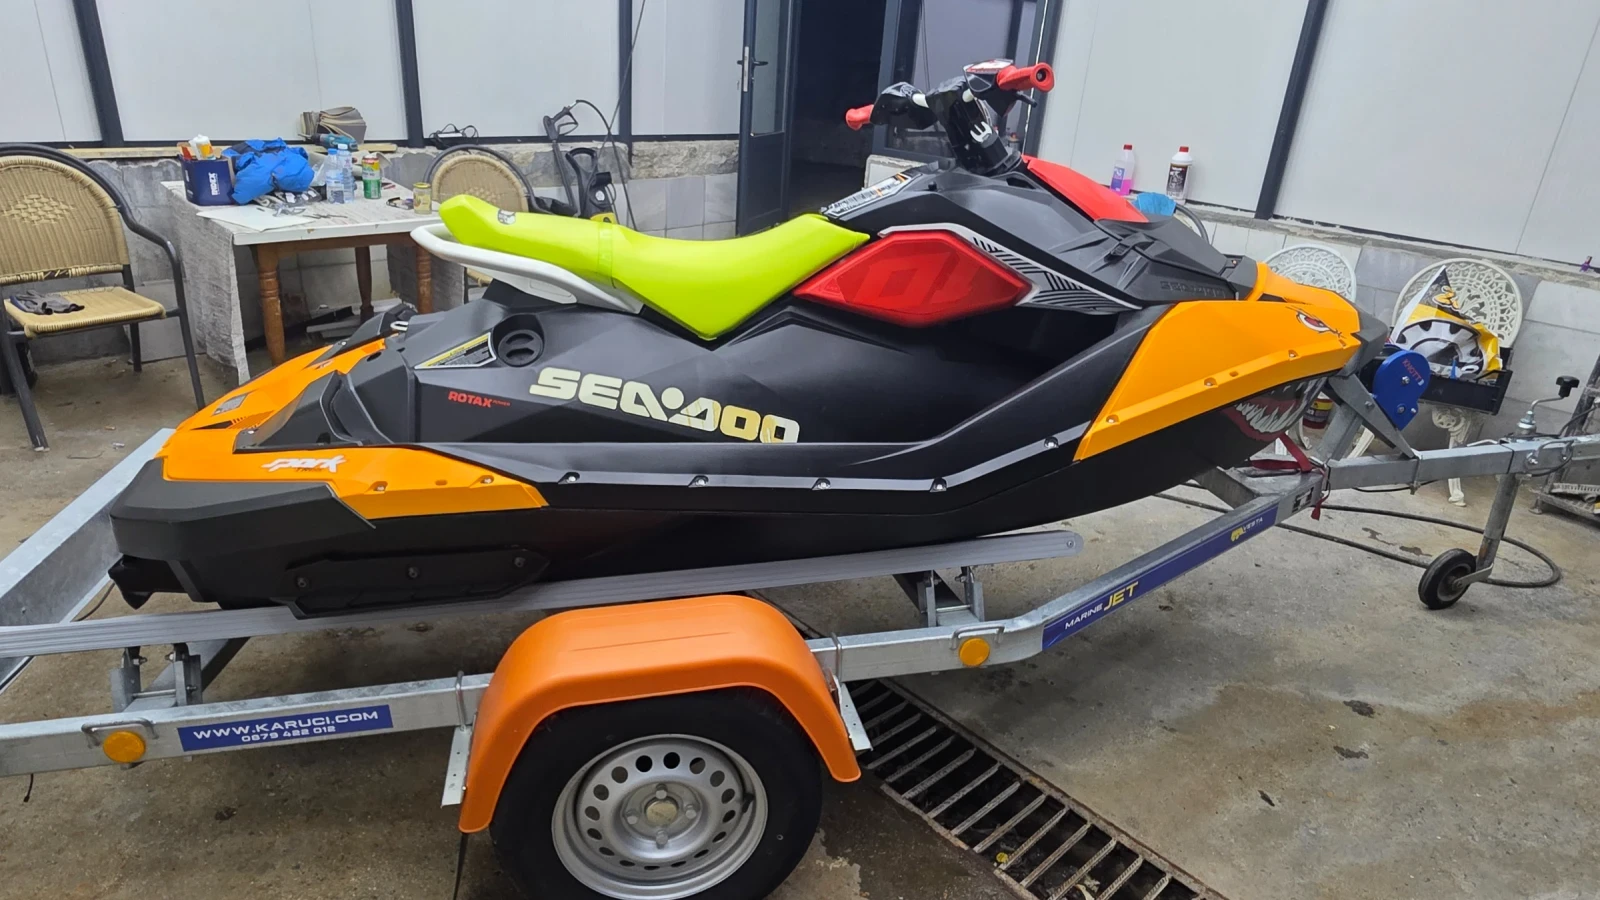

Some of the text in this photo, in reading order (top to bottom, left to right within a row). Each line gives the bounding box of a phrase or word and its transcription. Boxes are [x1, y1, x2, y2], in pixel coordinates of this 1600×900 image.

[448, 391, 492, 408] ROTAX
[1064, 581, 1139, 629] MARINE JET
[193, 711, 379, 740] WWW.KARUCI.COM
[282, 728, 310, 738] 422
[313, 725, 336, 734] 012
